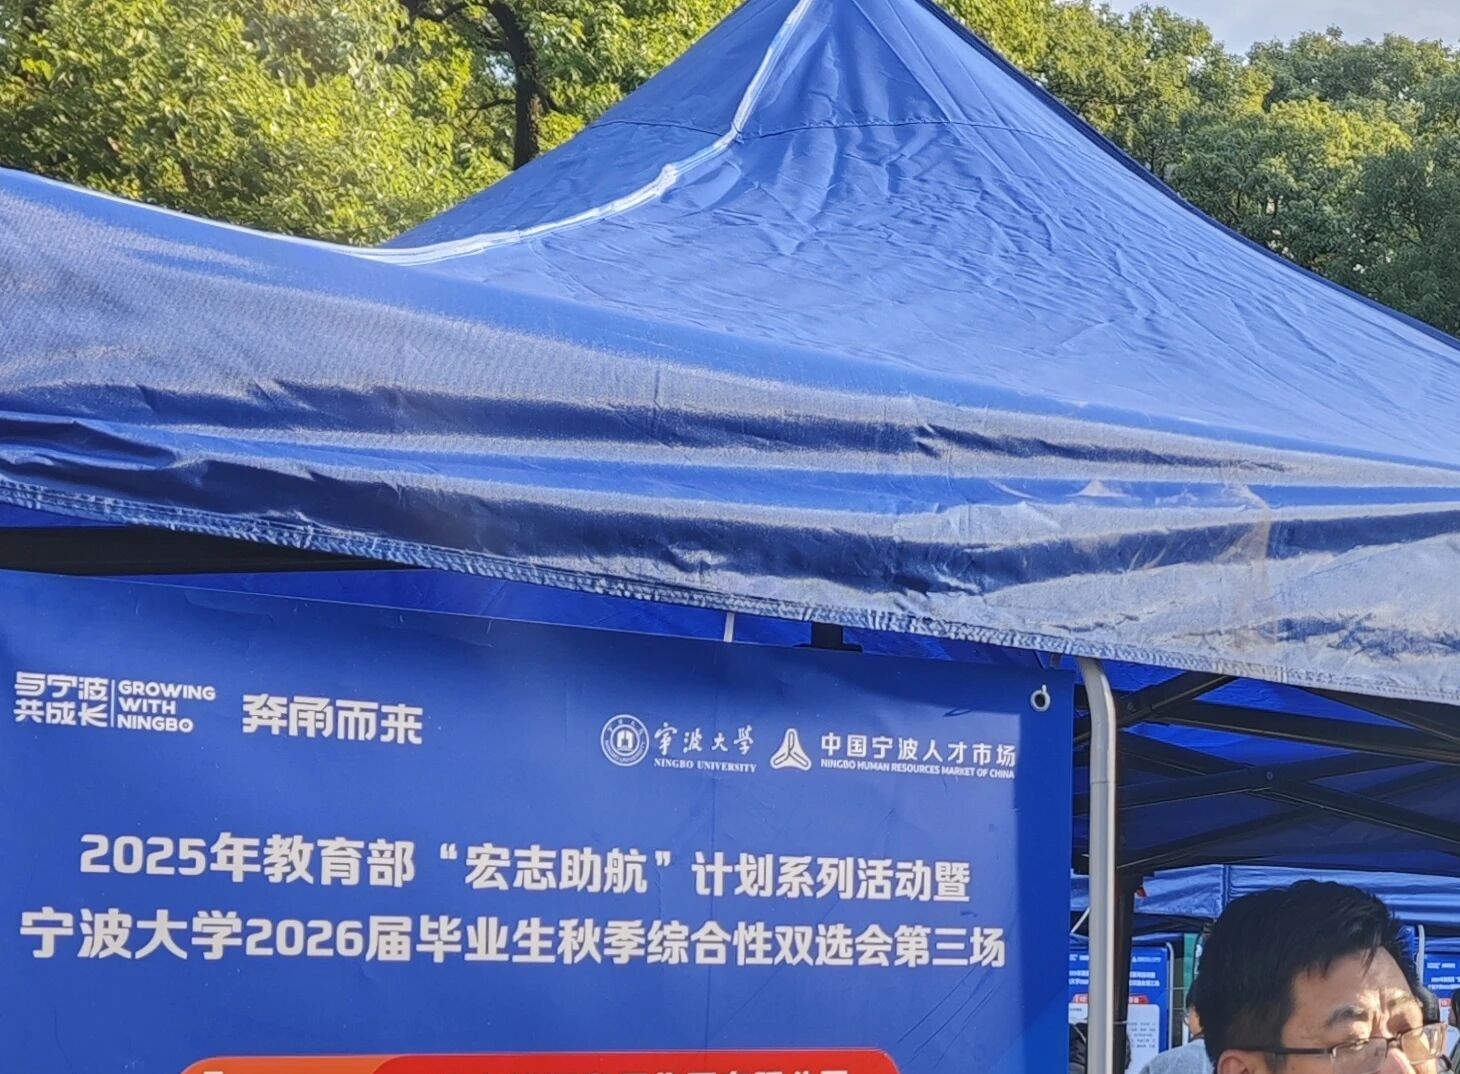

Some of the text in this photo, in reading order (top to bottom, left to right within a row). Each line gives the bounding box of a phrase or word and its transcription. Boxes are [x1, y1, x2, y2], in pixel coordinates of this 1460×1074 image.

[14, 671, 108, 700] 与宁波
[118, 680, 216, 701] GROWING
[14, 699, 107, 728] 共成长
[118, 697, 176, 715] WITH
[242, 693, 423, 744] 奔甬而来
[117, 714, 194, 733] NINGBO
[821, 732, 1016, 767] 中国宁波人才市场
[653, 758, 757, 773] NINGBO UNIVERSITY
[820, 758, 1015, 779] NINGBO HUMAN RESOURCES MARKET OF CHINA
[20, 906, 1006, 968] 宁波大学2026届毕业生秋季综合性双选会第三场
